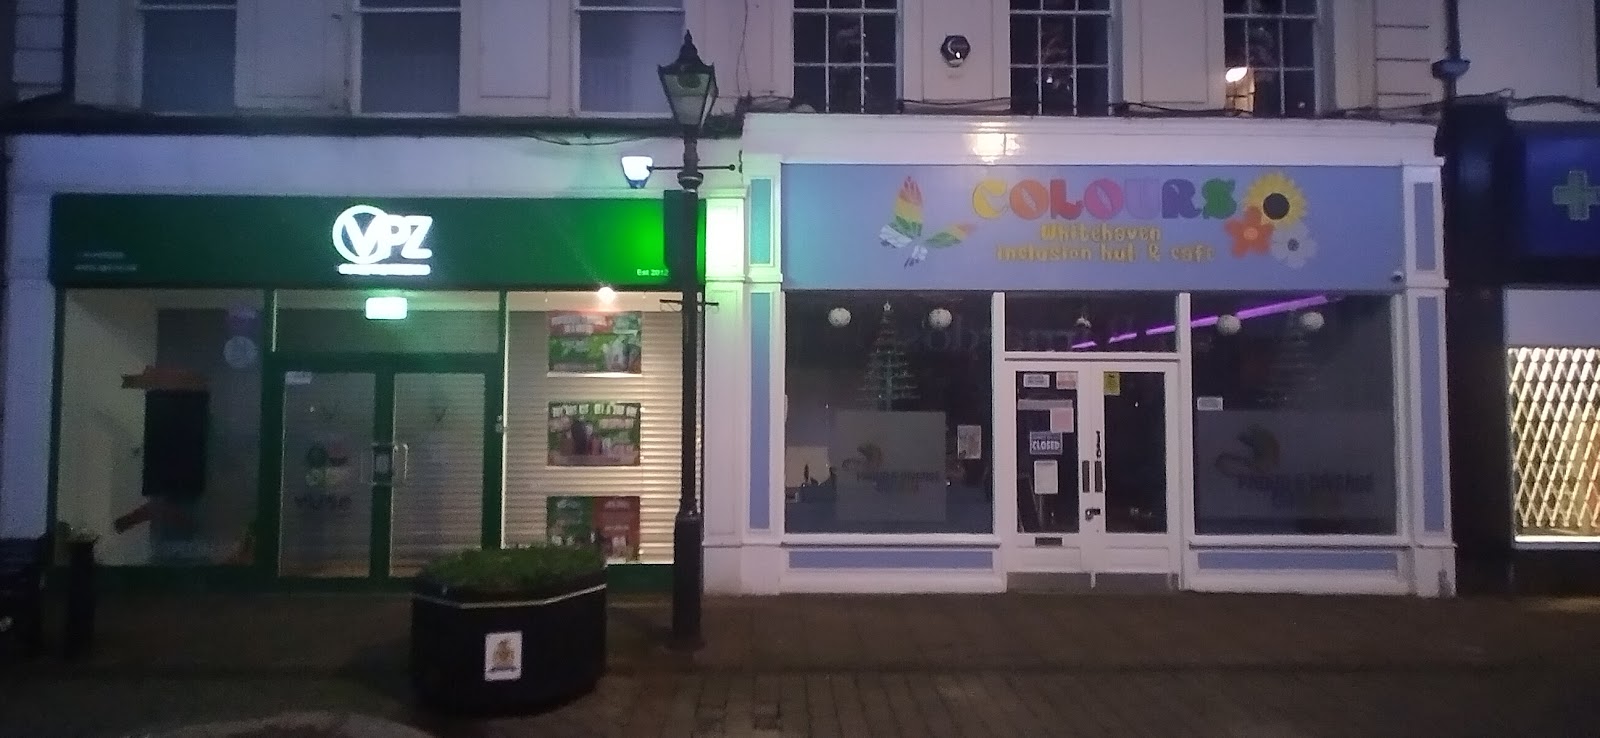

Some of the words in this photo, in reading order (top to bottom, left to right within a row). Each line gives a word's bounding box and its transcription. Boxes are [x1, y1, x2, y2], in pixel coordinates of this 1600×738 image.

[972, 178, 1237, 220] COLOURS
[332, 205, 433, 264] VPZ
[1040, 223, 1161, 242] Whitehaven
[1148, 244, 1160, 261] &
[636, 268, 650, 276] Est
[1032, 440, 1060, 450] CLOSED
